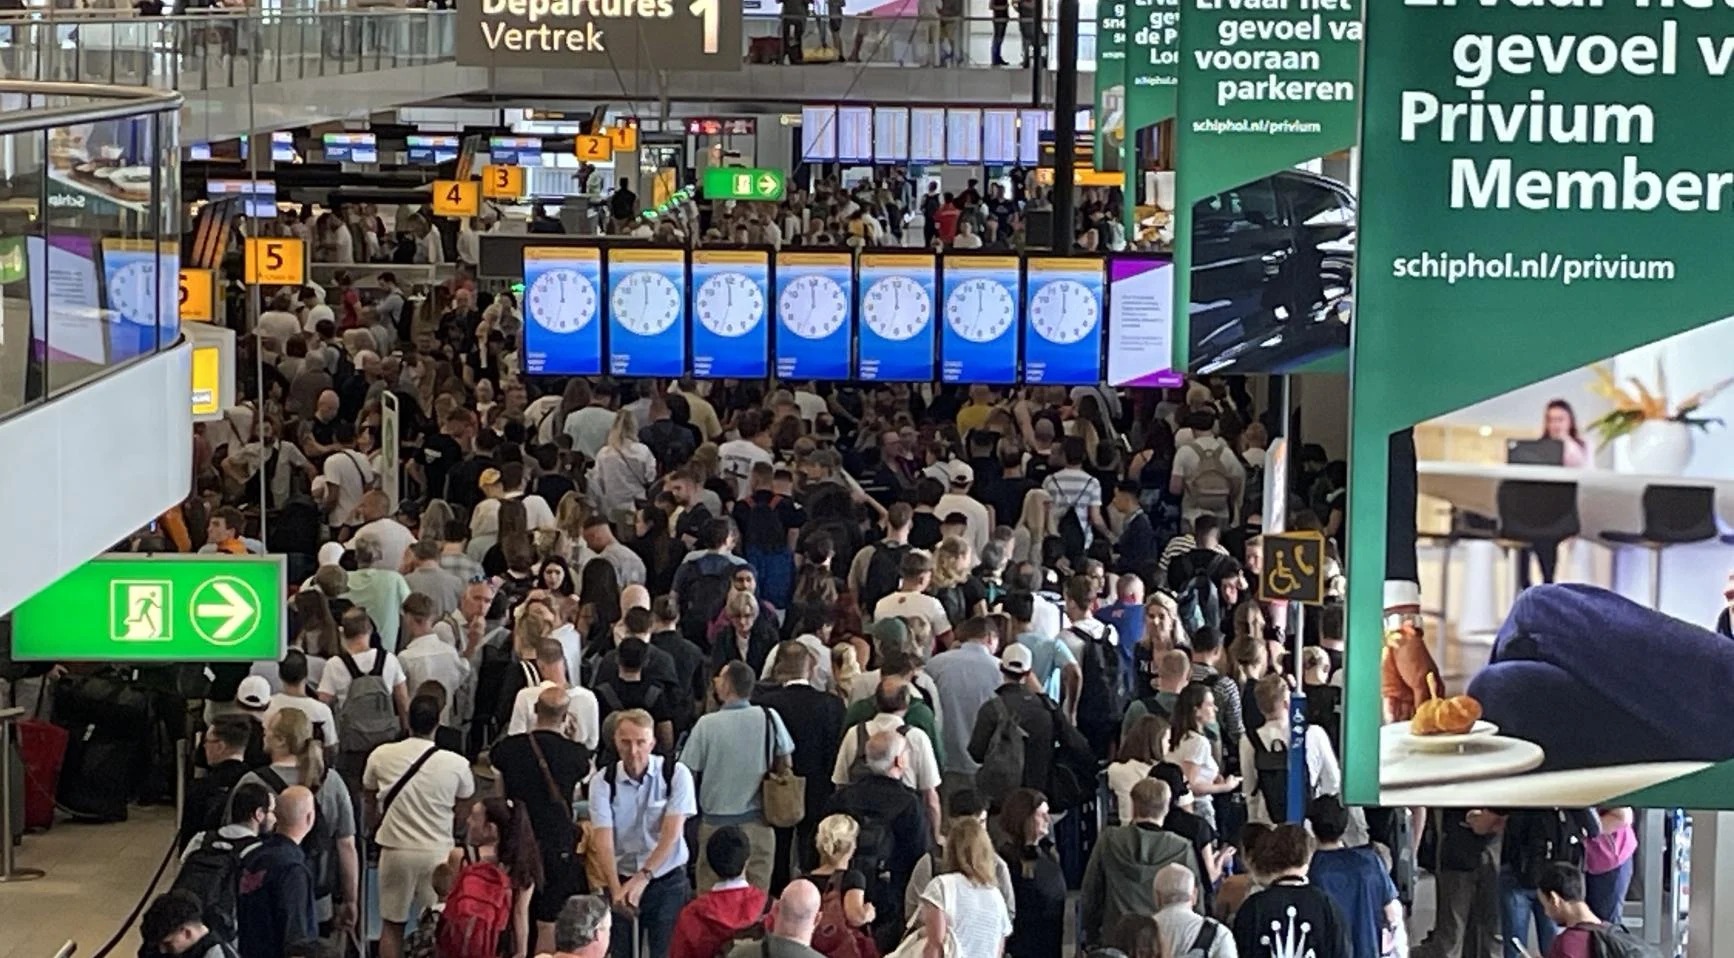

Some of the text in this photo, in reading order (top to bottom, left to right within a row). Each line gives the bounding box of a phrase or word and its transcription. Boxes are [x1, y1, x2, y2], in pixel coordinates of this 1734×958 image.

[481, 21, 605, 51] Vertrek
[1135, 26, 1161, 45] de
[1218, 13, 1363, 46] gevoel va
[1194, 50, 1320, 70] vooraan
[1453, 20, 1677, 88] gevoel
[1218, 73, 1354, 106] parkeren
[1192, 118, 1321, 134] schiphol.nl/privium
[1400, 88, 1654, 144] Privium
[587, 138, 598, 154] 2
[618, 129, 626, 144] 1
[496, 169, 509, 188] 3
[1450, 155, 1734, 211] Member
[446, 184, 462, 205] 4
[266, 243, 283, 271] 5
[1393, 251, 1675, 284] schiphol.nl/privium
